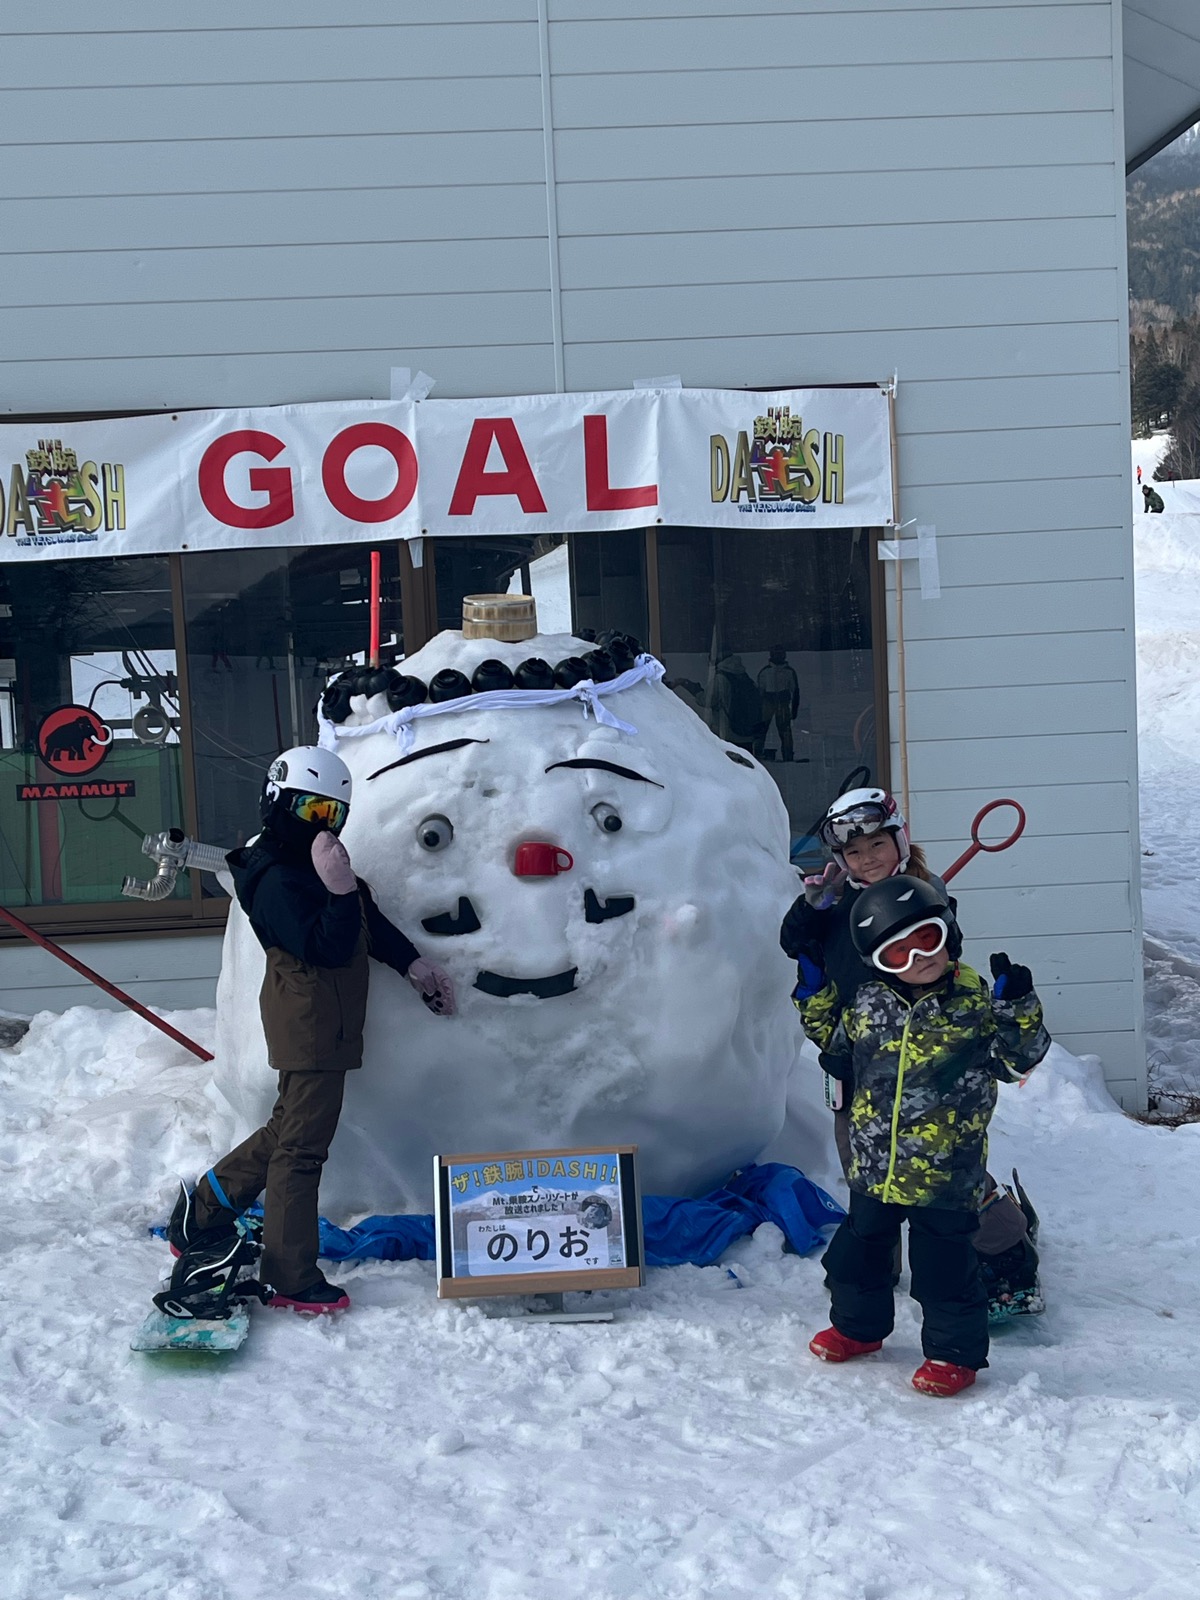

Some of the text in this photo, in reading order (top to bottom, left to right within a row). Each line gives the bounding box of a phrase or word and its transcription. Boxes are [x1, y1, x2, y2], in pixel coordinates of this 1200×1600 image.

[768, 406, 790, 418] THE
[754, 415, 802, 440] 鉄腕
[198, 414, 659, 530] GOAL
[709, 428, 845, 505] DASH
[0, 460, 127, 538] ASH
[21, 783, 129, 799] MAMMUT
[531, 1185, 539, 1194] で
[478, 1224, 506, 1233] わたしは
[487, 1226, 590, 1262] のりお
[584, 1256, 600, 1265] です
